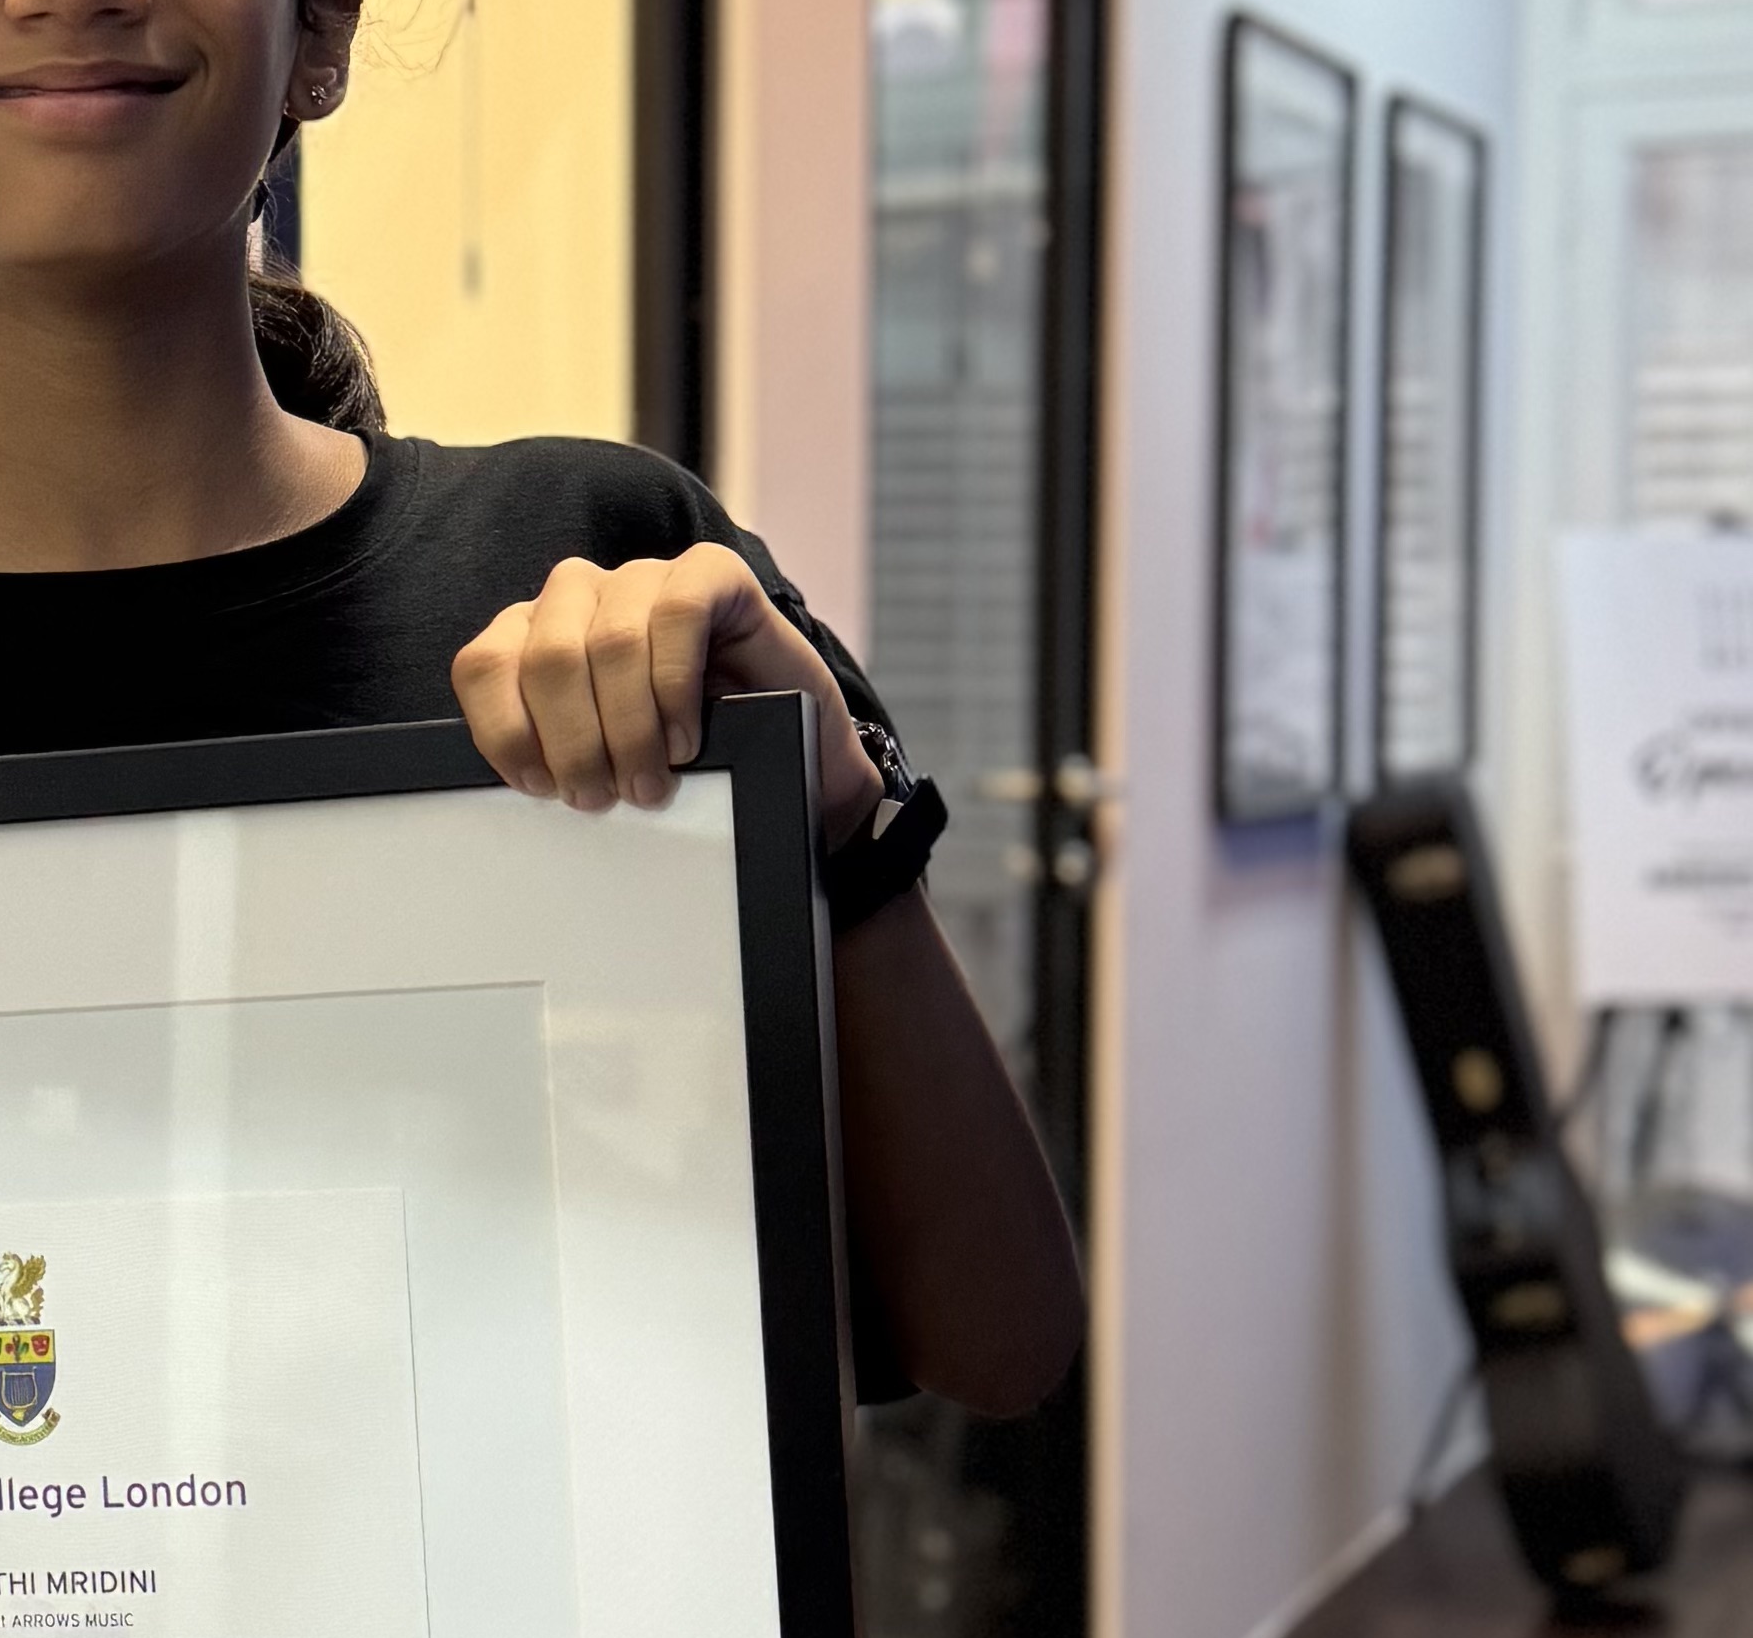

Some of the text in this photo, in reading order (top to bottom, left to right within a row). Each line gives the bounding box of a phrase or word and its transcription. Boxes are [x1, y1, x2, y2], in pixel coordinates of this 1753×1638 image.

[102, 1473, 247, 1509] London
[47, 1570, 157, 1595] MRIDINI
[12, 1613, 80, 1628] ARROWS
[85, 1613, 134, 1627] MUSIC
